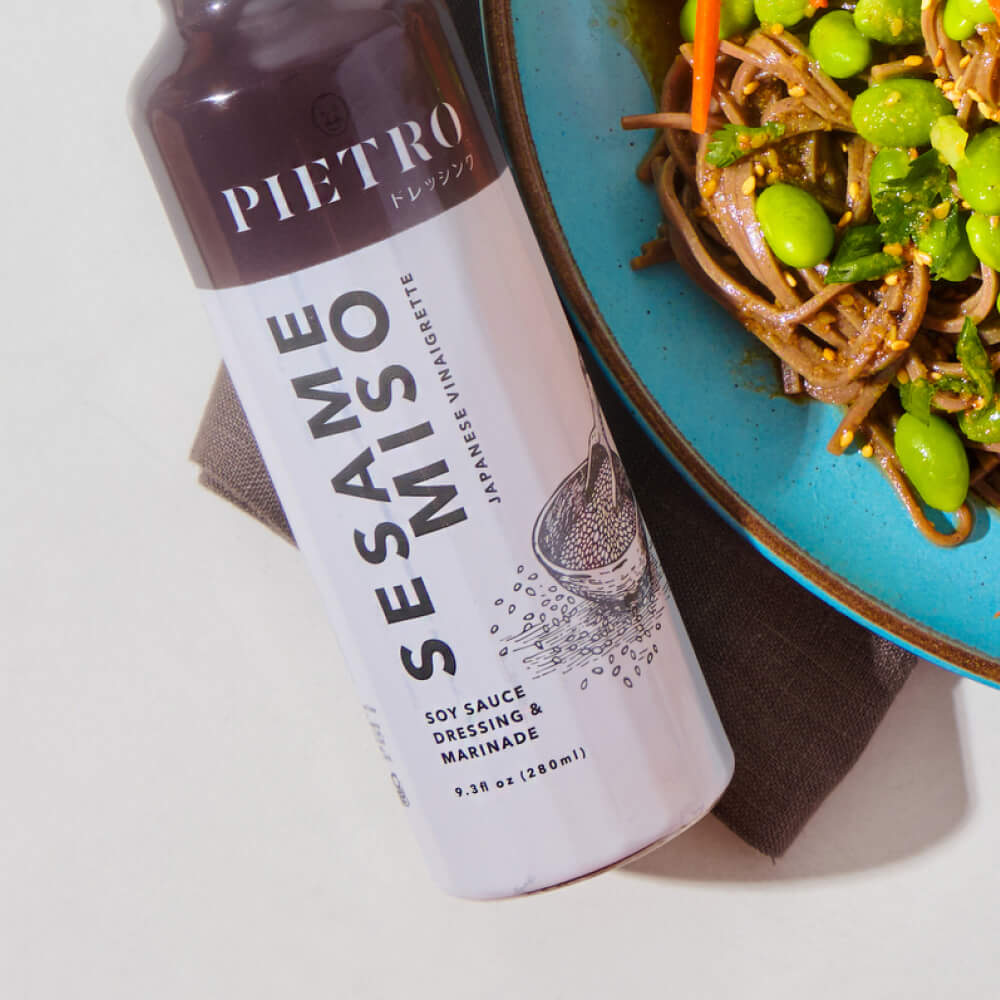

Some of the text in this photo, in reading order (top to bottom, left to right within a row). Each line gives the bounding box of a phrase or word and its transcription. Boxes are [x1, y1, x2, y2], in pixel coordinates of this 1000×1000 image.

[220, 102, 463, 233] PIETRO
[329, 289, 468, 538] MISO
[400, 272, 501, 504] JAPANESE VINAIGRETTE
[266, 304, 458, 681] SESAME
[425, 685, 527, 726] SOY SAUCE
[433, 702, 543, 745] DRESSING &
[440, 727, 540, 765] MARINADE
[455, 747, 587, 798] 9.3fl oz (280ml)
